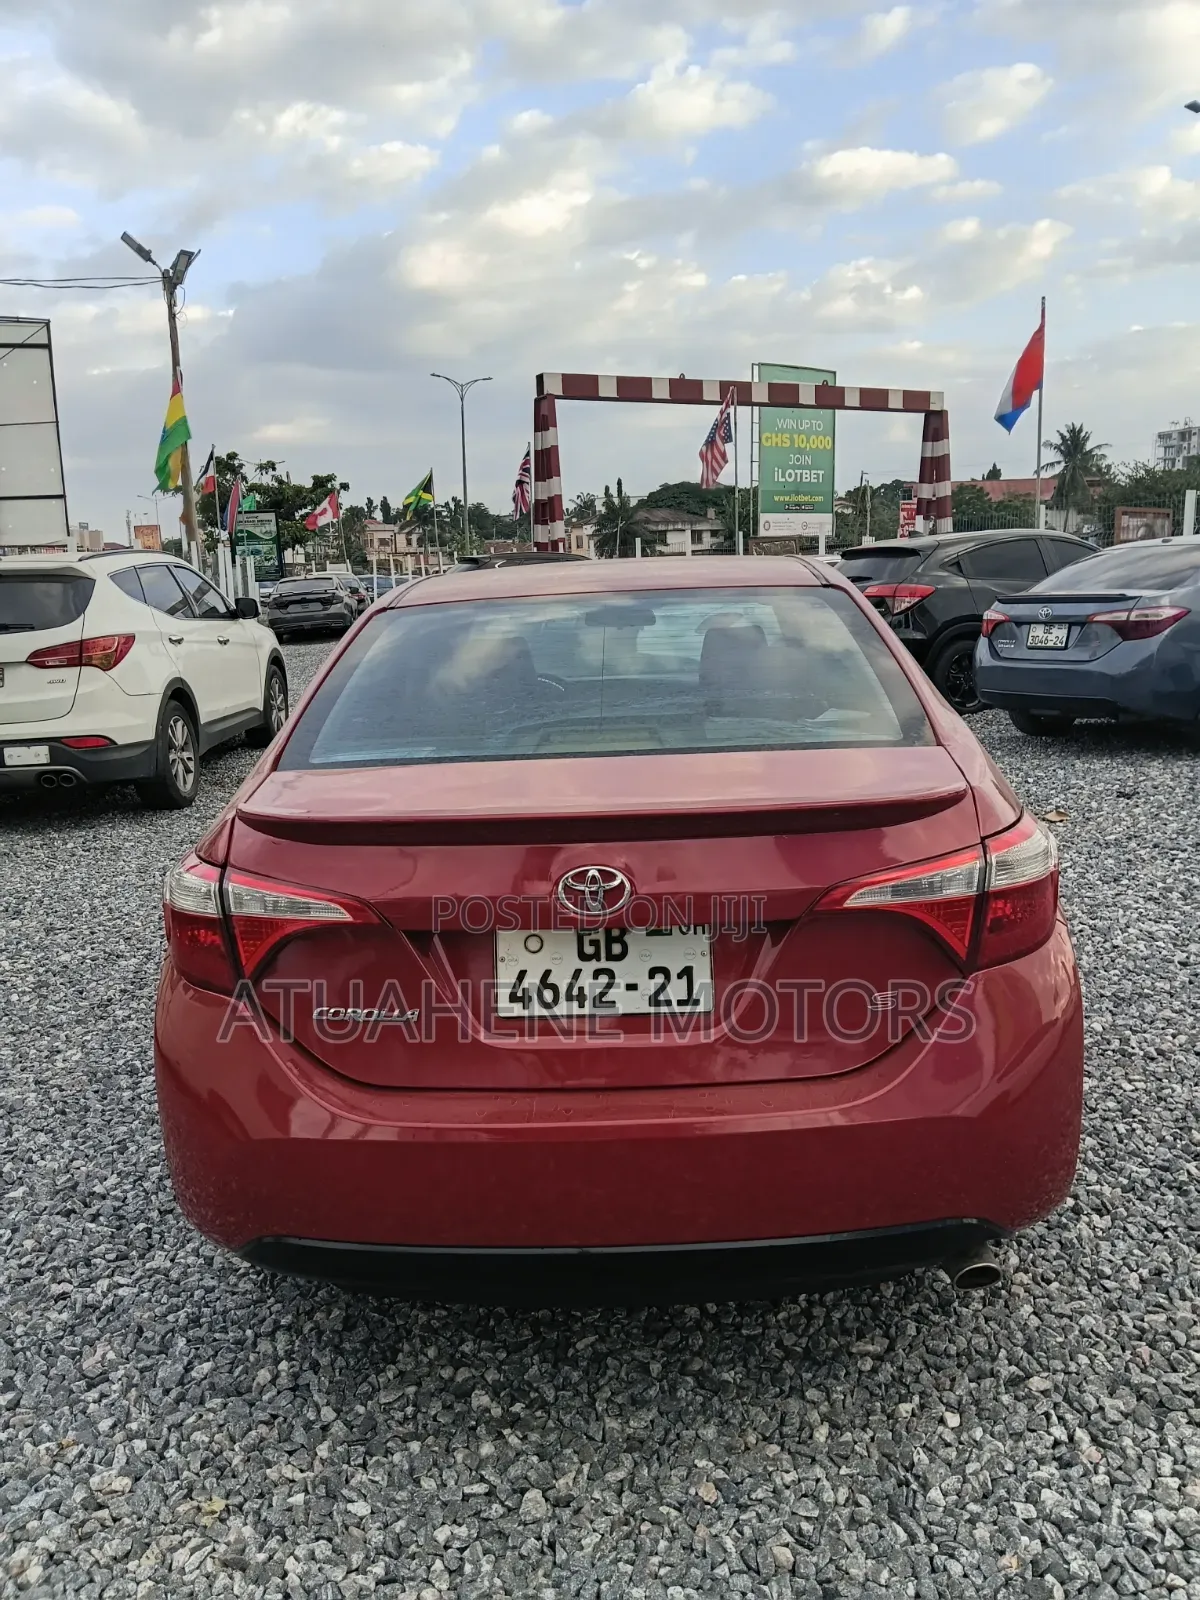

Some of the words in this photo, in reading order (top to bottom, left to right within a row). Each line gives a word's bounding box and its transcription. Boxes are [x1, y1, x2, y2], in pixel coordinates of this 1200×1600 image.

[777, 418, 797, 430] WIN
[798, 419, 811, 430] UP
[811, 420, 824, 431] TO
[761, 433, 791, 448] GHS
[793, 434, 832, 451] 10,000
[788, 454, 812, 465] JOIN
[774, 467, 825, 483] iLOTBET
[1043, 624, 1054, 634] GE
[1029, 635, 1064, 646] 3046-24
[577, 928, 629, 963] GB
[508, 965, 701, 1010] 4642-21
[867, 990, 899, 1012] S
[312, 1006, 420, 1022] COROLLA
